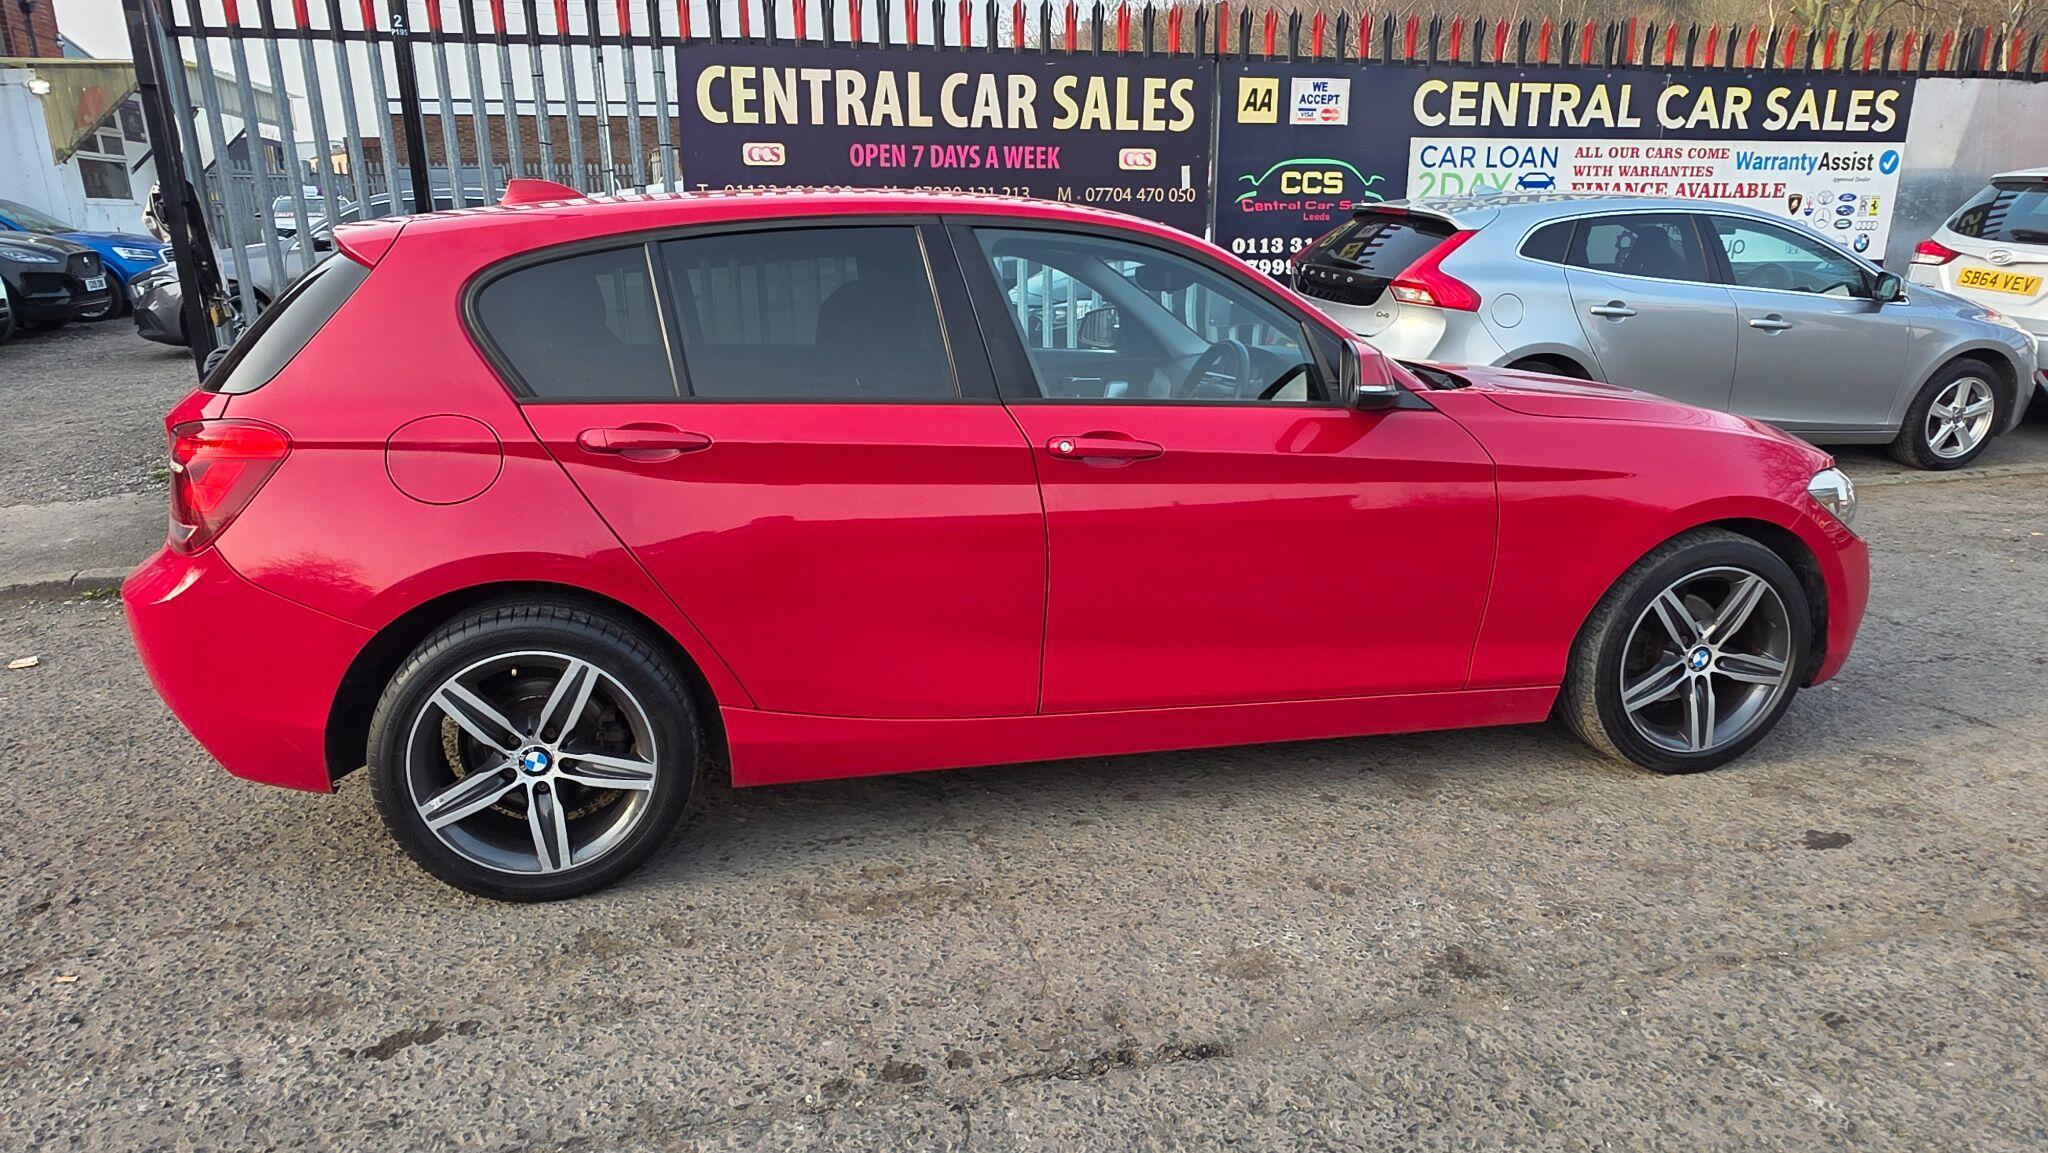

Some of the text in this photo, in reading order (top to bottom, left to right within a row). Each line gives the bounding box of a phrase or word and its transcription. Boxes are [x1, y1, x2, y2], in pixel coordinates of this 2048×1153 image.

[393, 14, 403, 28] 2
[1312, 82, 1328, 92] WE
[696, 65, 1194, 132] CENTRAL CAR SALES
[1243, 88, 1272, 112] AA
[1299, 94, 1340, 105] ACCEPT
[1414, 79, 1899, 132] CENTRAL CAR SALES
[850, 144, 1061, 169] OPEN 7 DAYS A WEEK
[1420, 145, 1559, 168] CAR LOAN
[1574, 147, 1730, 159] ALL OUR CARS COME
[1573, 165, 1714, 177] WITH WARRANTIES
[1281, 171, 1343, 194] CCS
[1418, 172, 1513, 199] 2DAY
[1675, 182, 1786, 199] AVAILABLE
[1057, 187, 1072, 202] M
[1085, 187, 1132, 202] 07704
[1136, 188, 1164, 203] 470
[1168, 188, 1196, 203] 050
[1242, 199, 1301, 212] Central
[1305, 201, 1335, 210] Car
[1303, 213, 1330, 221] Leeds
[1232, 238, 1284, 254] 0113
[1961, 270, 2036, 292] SB64 VEV
